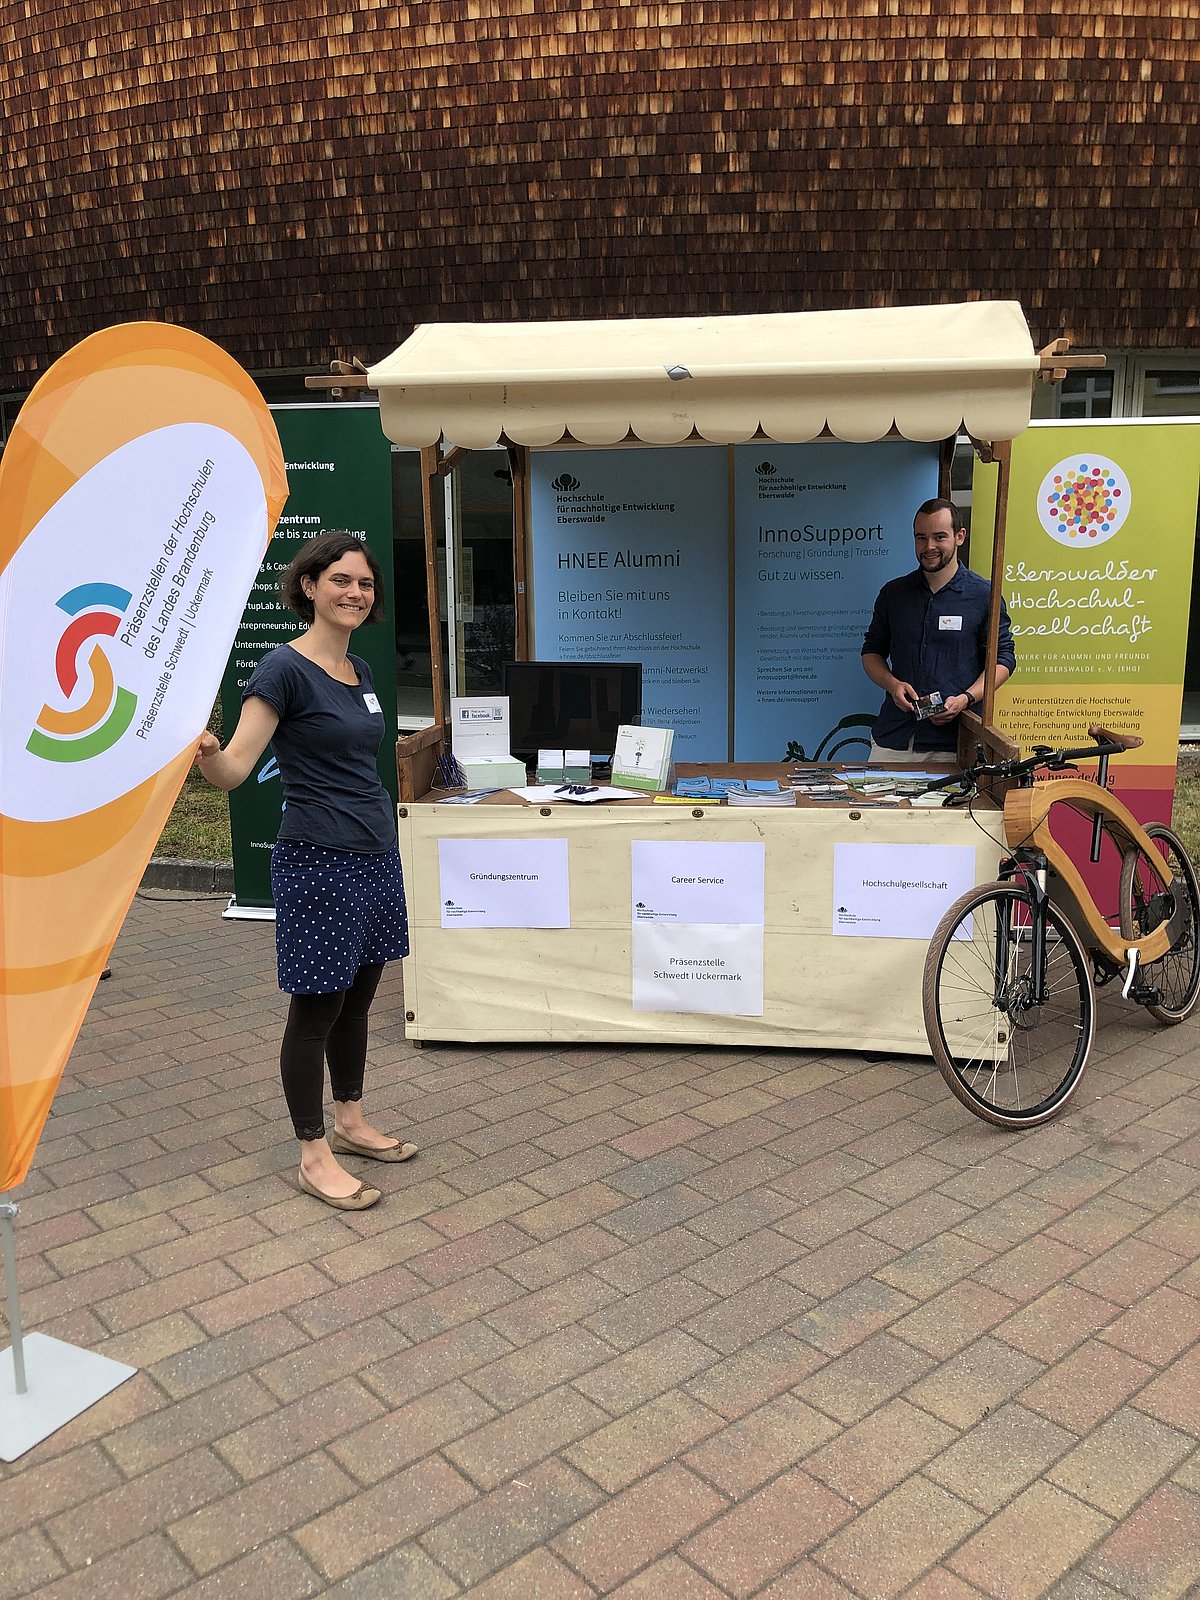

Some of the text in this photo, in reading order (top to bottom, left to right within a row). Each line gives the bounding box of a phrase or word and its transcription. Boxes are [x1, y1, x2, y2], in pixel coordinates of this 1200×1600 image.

[285, 461, 334, 471] Entwicklung
[557, 493, 604, 502] Hochschule
[557, 502, 675, 513] für nachhaltige Entwicklung
[278, 515, 320, 524] zentrum
[557, 514, 605, 523] Eberswalde
[287, 528, 300, 538] bis
[303, 530, 317, 538] zur
[758, 524, 883, 546] InnoSupport
[120, 459, 215, 647] Präsenzstellen der Hochschulen
[758, 549, 801, 559] Forschung
[807, 548, 849, 558] Gründung
[855, 547, 889, 556] Transfer
[558, 550, 680, 569] HNEE Alumni
[266, 562, 272, 570] &
[1005, 560, 1157, 581] Eberswalder
[758, 568, 844, 581] Gut zu wissen.
[143, 511, 216, 659] des Landes Brandenburg
[558, 589, 670, 602] Bleiben Sie mit uns
[1009, 588, 1144, 609] Hochschul-
[275, 602, 281, 610] &
[558, 608, 622, 619] in Kontakt!
[238, 622, 297, 631] ntrepreneurship
[1012, 615, 1152, 643] esellschaft
[558, 634, 594, 642] Kommen
[596, 633, 608, 641] Sie
[624, 632, 682, 641] Abschlussfeier!
[234, 641, 283, 649] Unternehme
[136, 671, 172, 740] Präsenzstelle
[164, 627, 189, 670] Schwedt
[185, 568, 213, 620] Uckermark
[1043, 652, 1058, 660] FÜR
[642, 666, 708, 675] umni-Netzwerks!
[1118, 665, 1140, 673] (EHG)
[1027, 697, 1074, 705] unterstützen
[647, 706, 701, 715] Wiedersehen!
[998, 709, 1144, 718] für nachhaltige Entwicklung Eberswalde
[1009, 722, 1031, 730] Lehre,
[1033, 722, 1070, 730] Forschung
[1089, 721, 1140, 730] Weiterbildung
[1019, 733, 1046, 741] fördern
[469, 871, 539, 882] Gründungszentrum
[671, 876, 725, 885] Career Service
[862, 879, 948, 890] Hochschulgesellschaft
[669, 957, 725, 967] Präsenzstelle
[653, 970, 690, 981] Schwedt
[695, 971, 742, 982] Uckermark
